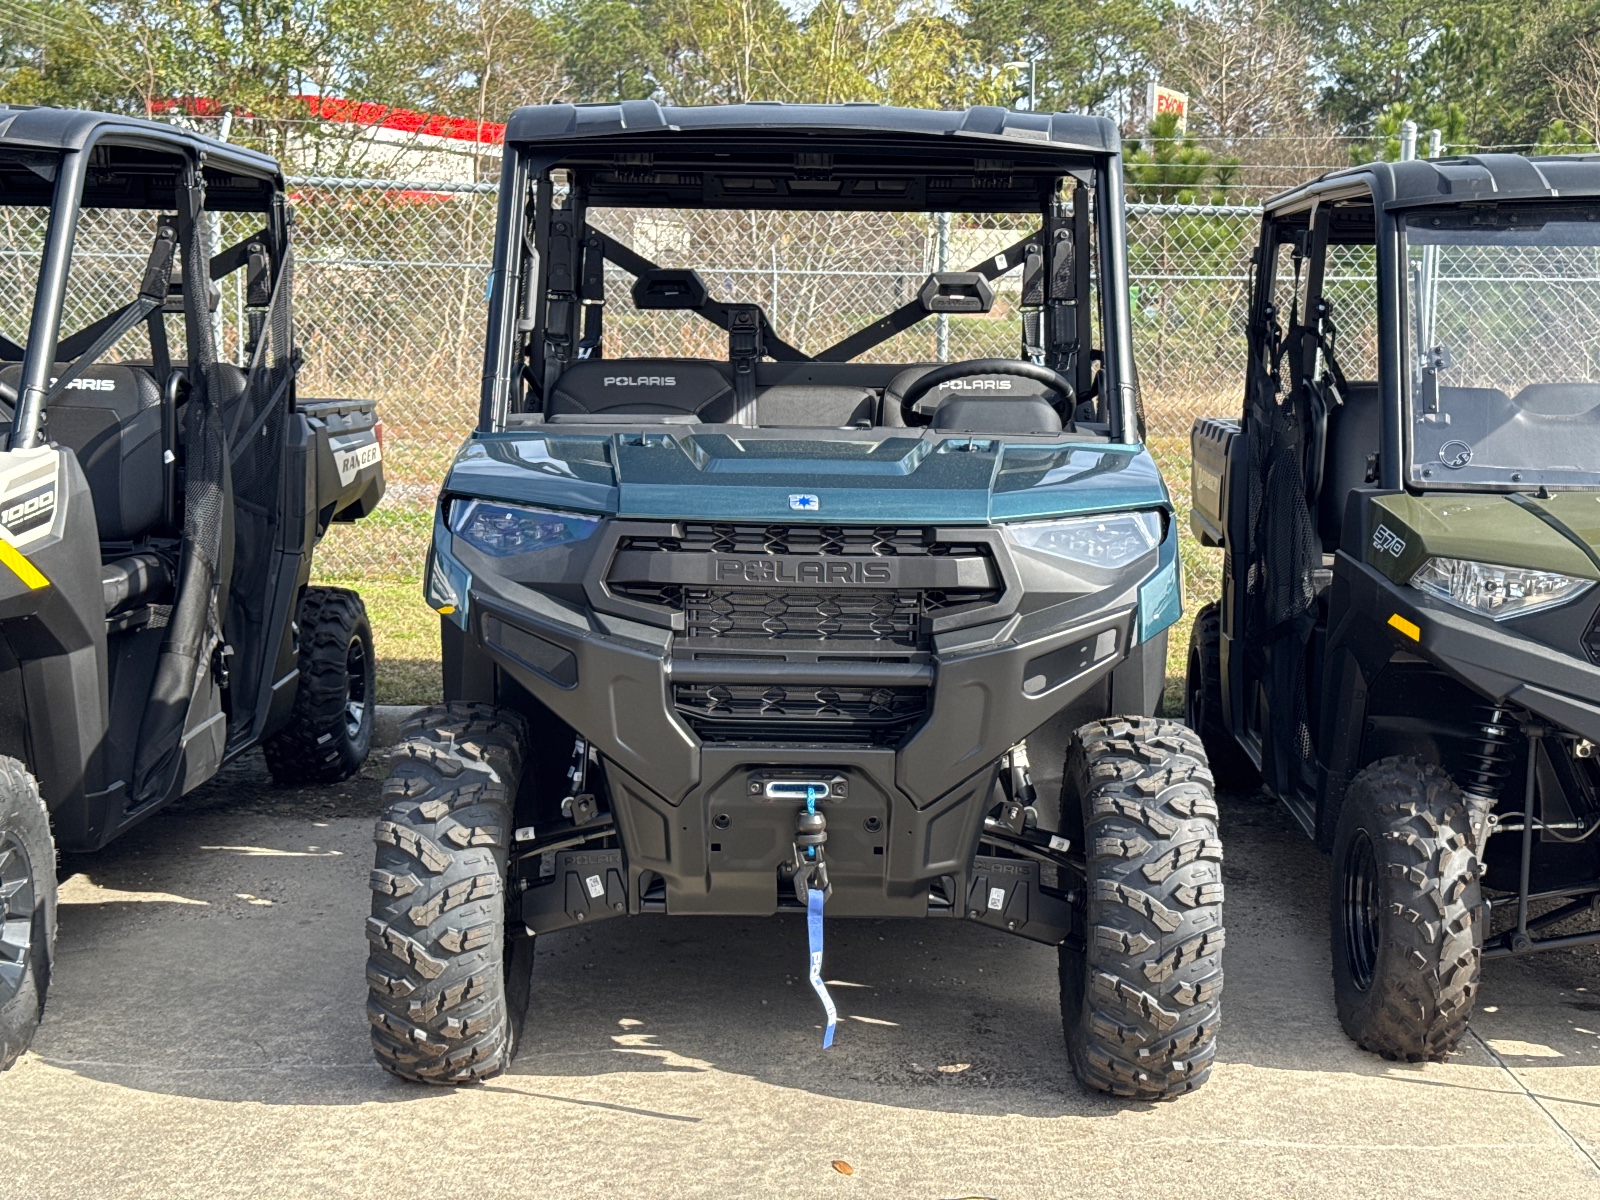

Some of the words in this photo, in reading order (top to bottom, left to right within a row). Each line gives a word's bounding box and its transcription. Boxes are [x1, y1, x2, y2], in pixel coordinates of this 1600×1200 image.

[49, 377, 116, 391] ARIS
[603, 376, 677, 387] POLARIS
[938, 380, 1012, 390] POLARIS
[342, 447, 377, 473] RANGER
[1, 490, 54, 524] 1000
[1373, 523, 1406, 558] 570
[715, 559, 892, 584] POLARIS
[564, 854, 621, 867] POLAR
[973, 861, 1030, 875] OLARIS
